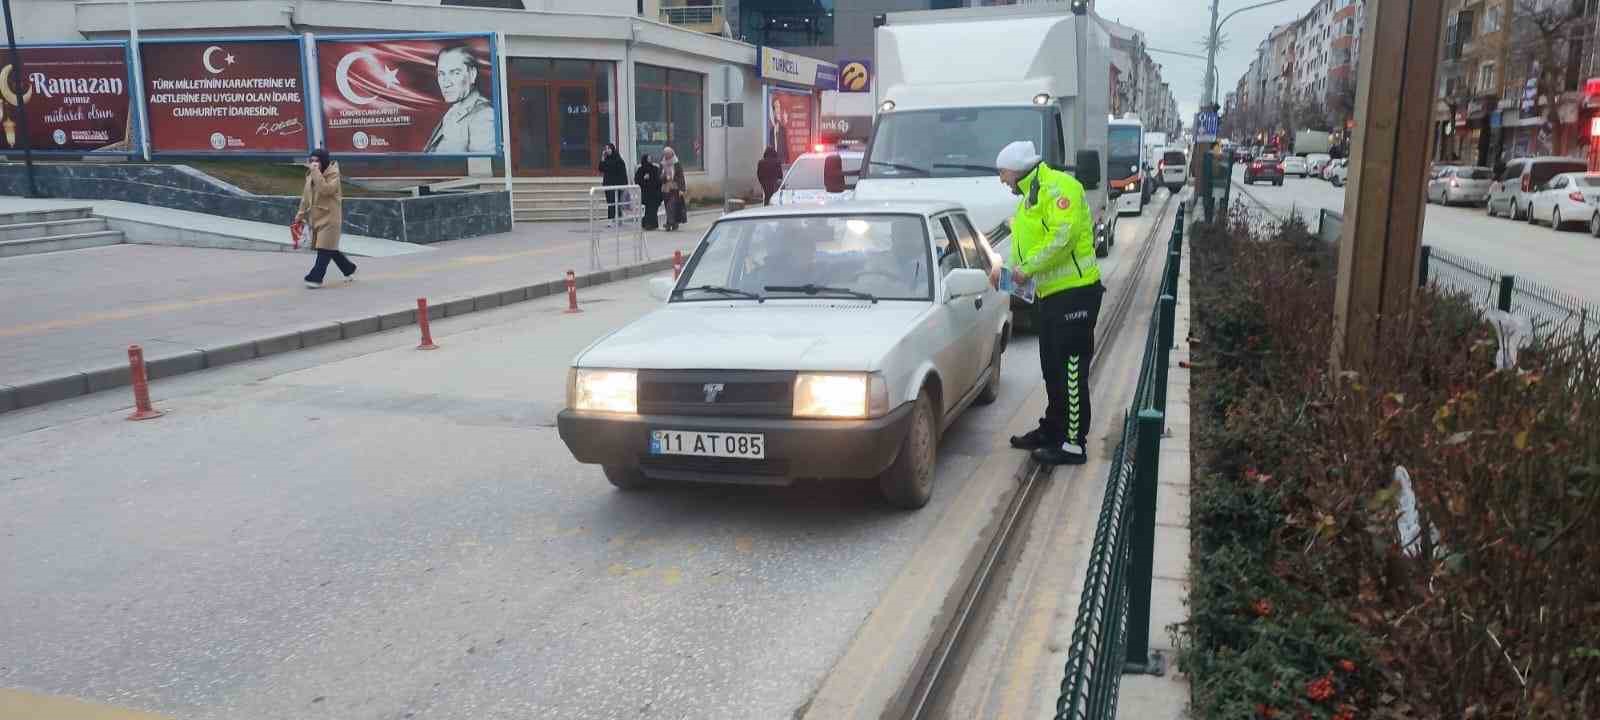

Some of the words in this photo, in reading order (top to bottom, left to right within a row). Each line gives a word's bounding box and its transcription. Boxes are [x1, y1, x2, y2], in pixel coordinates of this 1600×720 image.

[772, 56, 799, 75] TURKCELL
[29, 73, 123, 97] Ramazan
[152, 78, 175, 89] TÜRK
[175, 78, 222, 89] MİLLETİNİN
[223, 77, 284, 89] KARAKTERİNE
[285, 79, 296, 88] VE
[150, 93, 200, 103] ADETLERİNE
[201, 94, 212, 103] EN
[213, 93, 244, 103] UYGUN
[245, 93, 271, 102] OLAN
[87, 104, 113, 120] olsun
[173, 106, 228, 117] CUMHURİYET
[664, 433, 682, 451] 11
[694, 433, 720, 453] AT
[725, 435, 761, 455] 085
